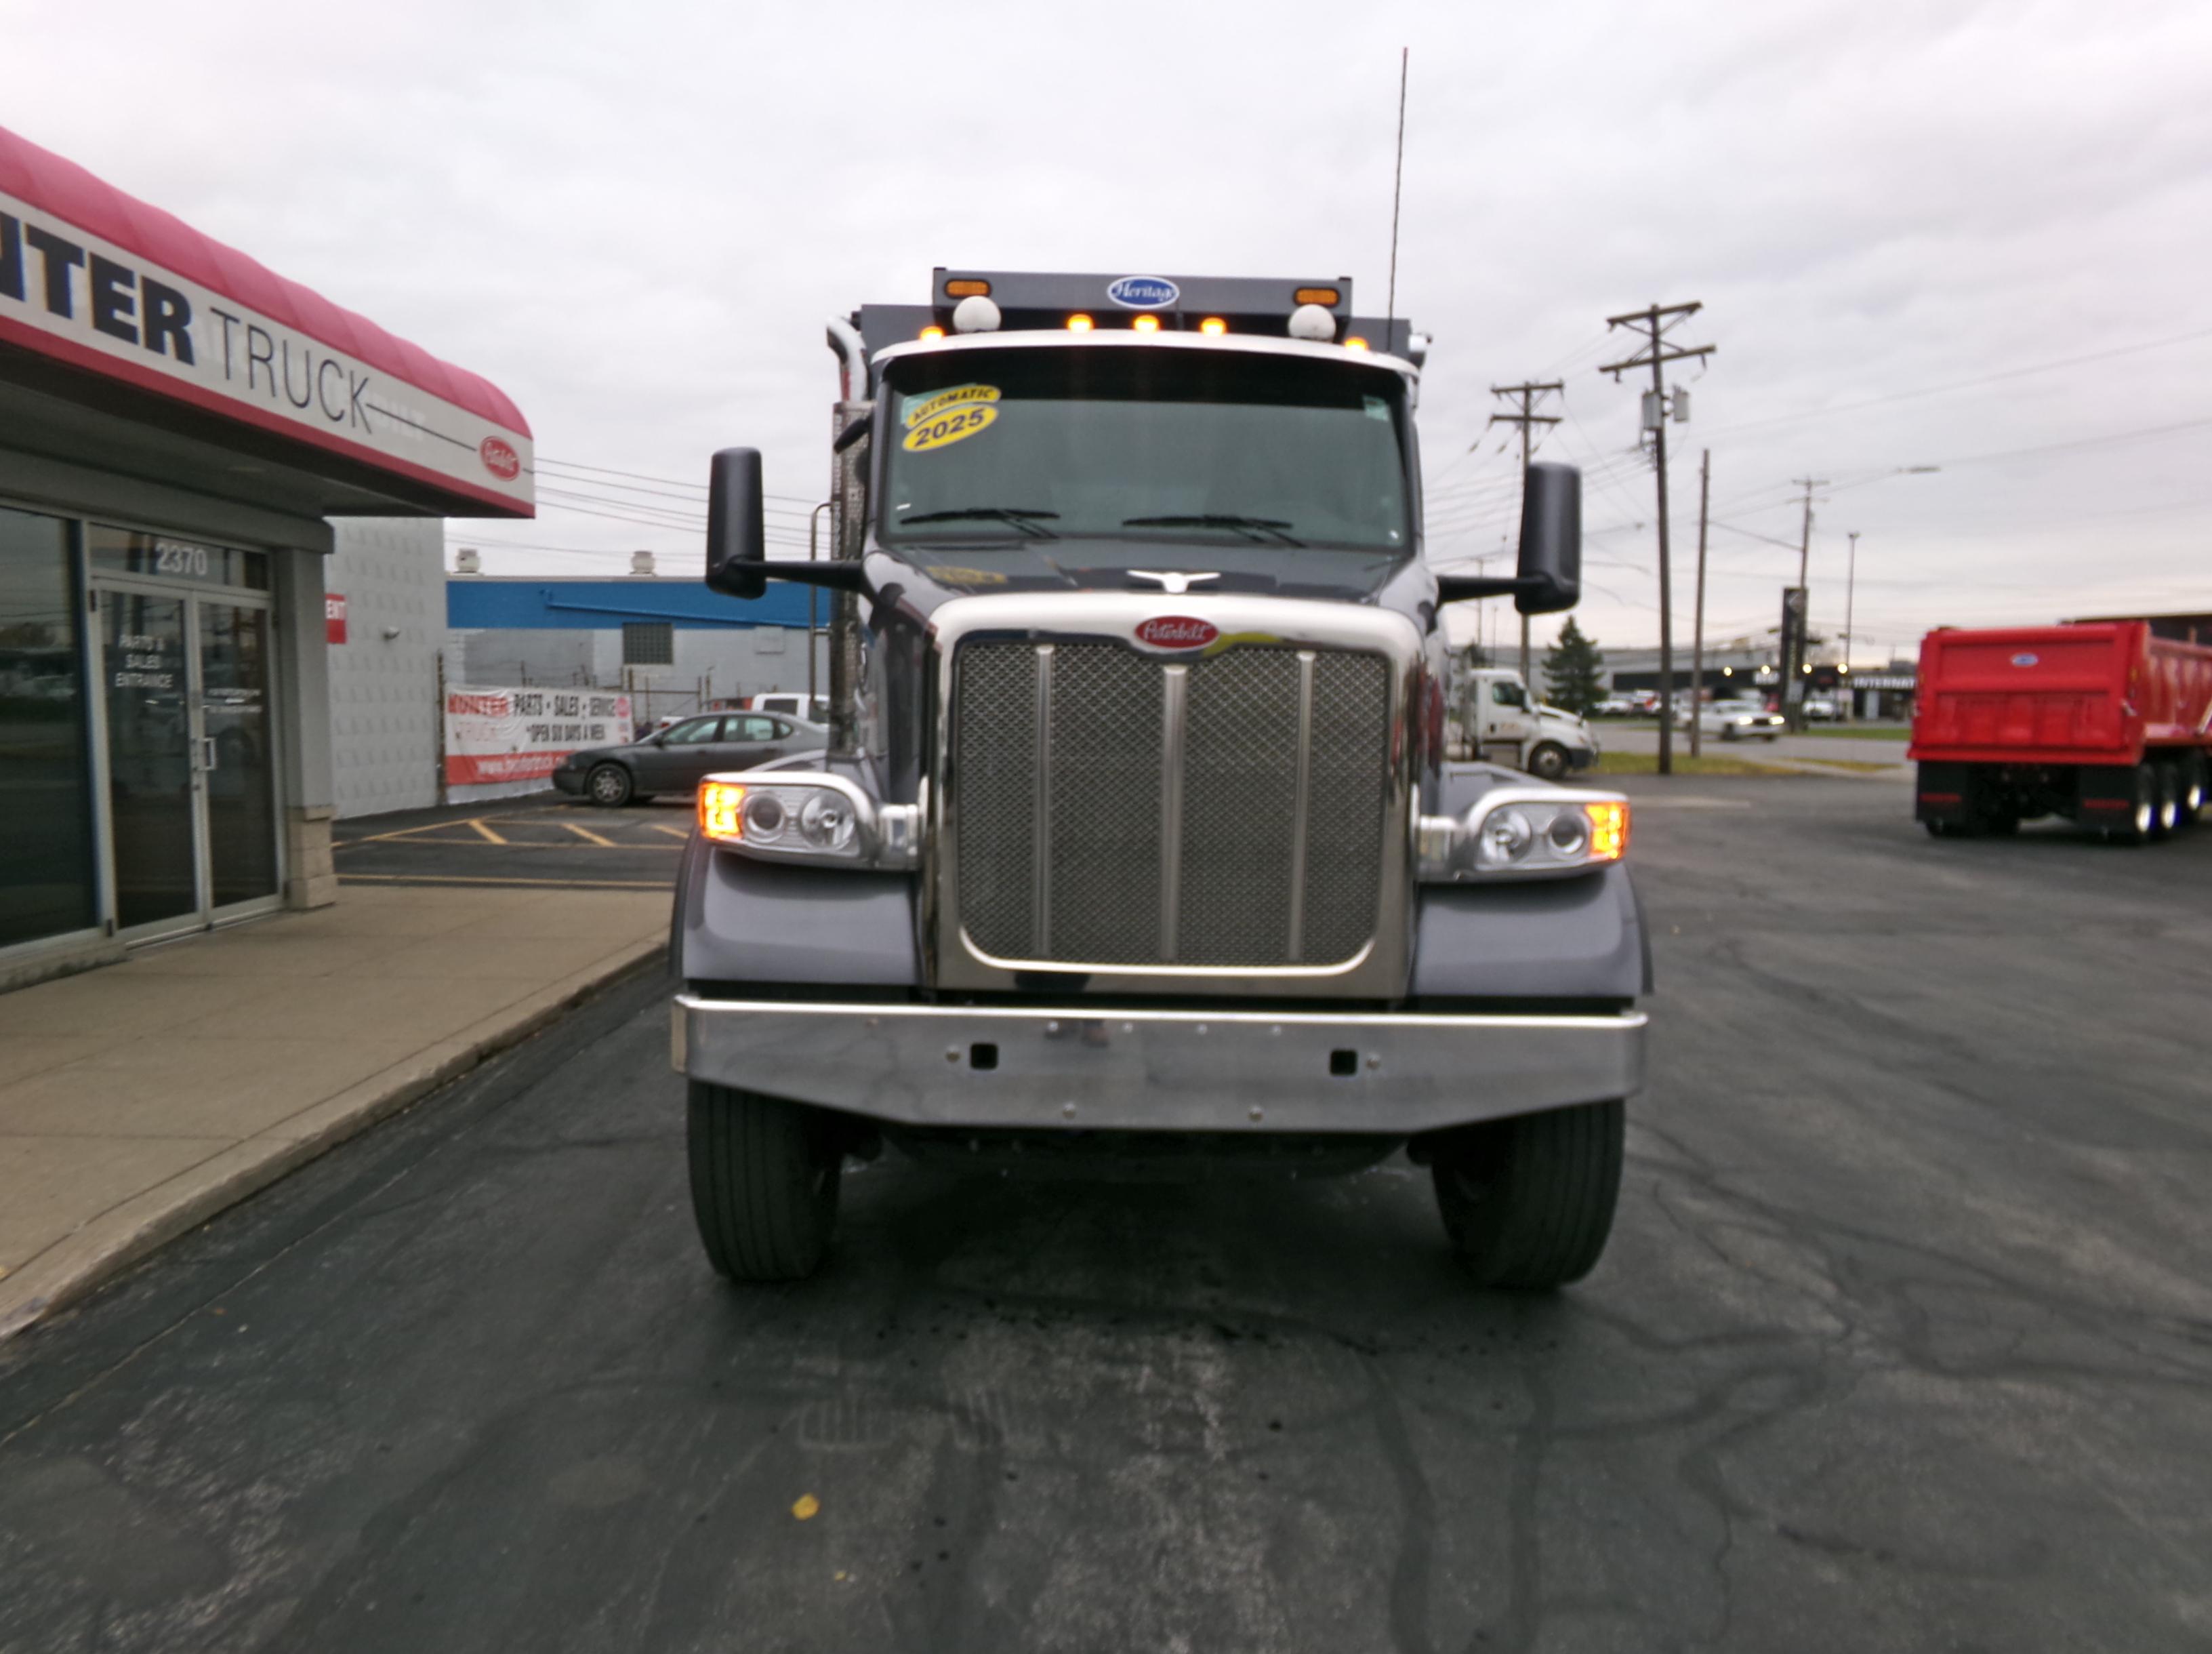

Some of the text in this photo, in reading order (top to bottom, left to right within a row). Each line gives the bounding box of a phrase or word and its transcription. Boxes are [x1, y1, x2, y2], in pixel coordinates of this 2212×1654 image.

[1111, 281, 1174, 303] Heritage
[210, 307, 372, 434] TRUCK
[914, 388, 992, 421] AUTOMATIC
[914, 407, 984, 447] 2025
[155, 542, 207, 576] 2370
[1143, 620, 1213, 641] Peterbilt
[125, 653, 162, 669] SALES
[115, 672, 173, 689] ENTRANCE
[513, 693, 543, 716] PARTS
[554, 693, 579, 717] SALES
